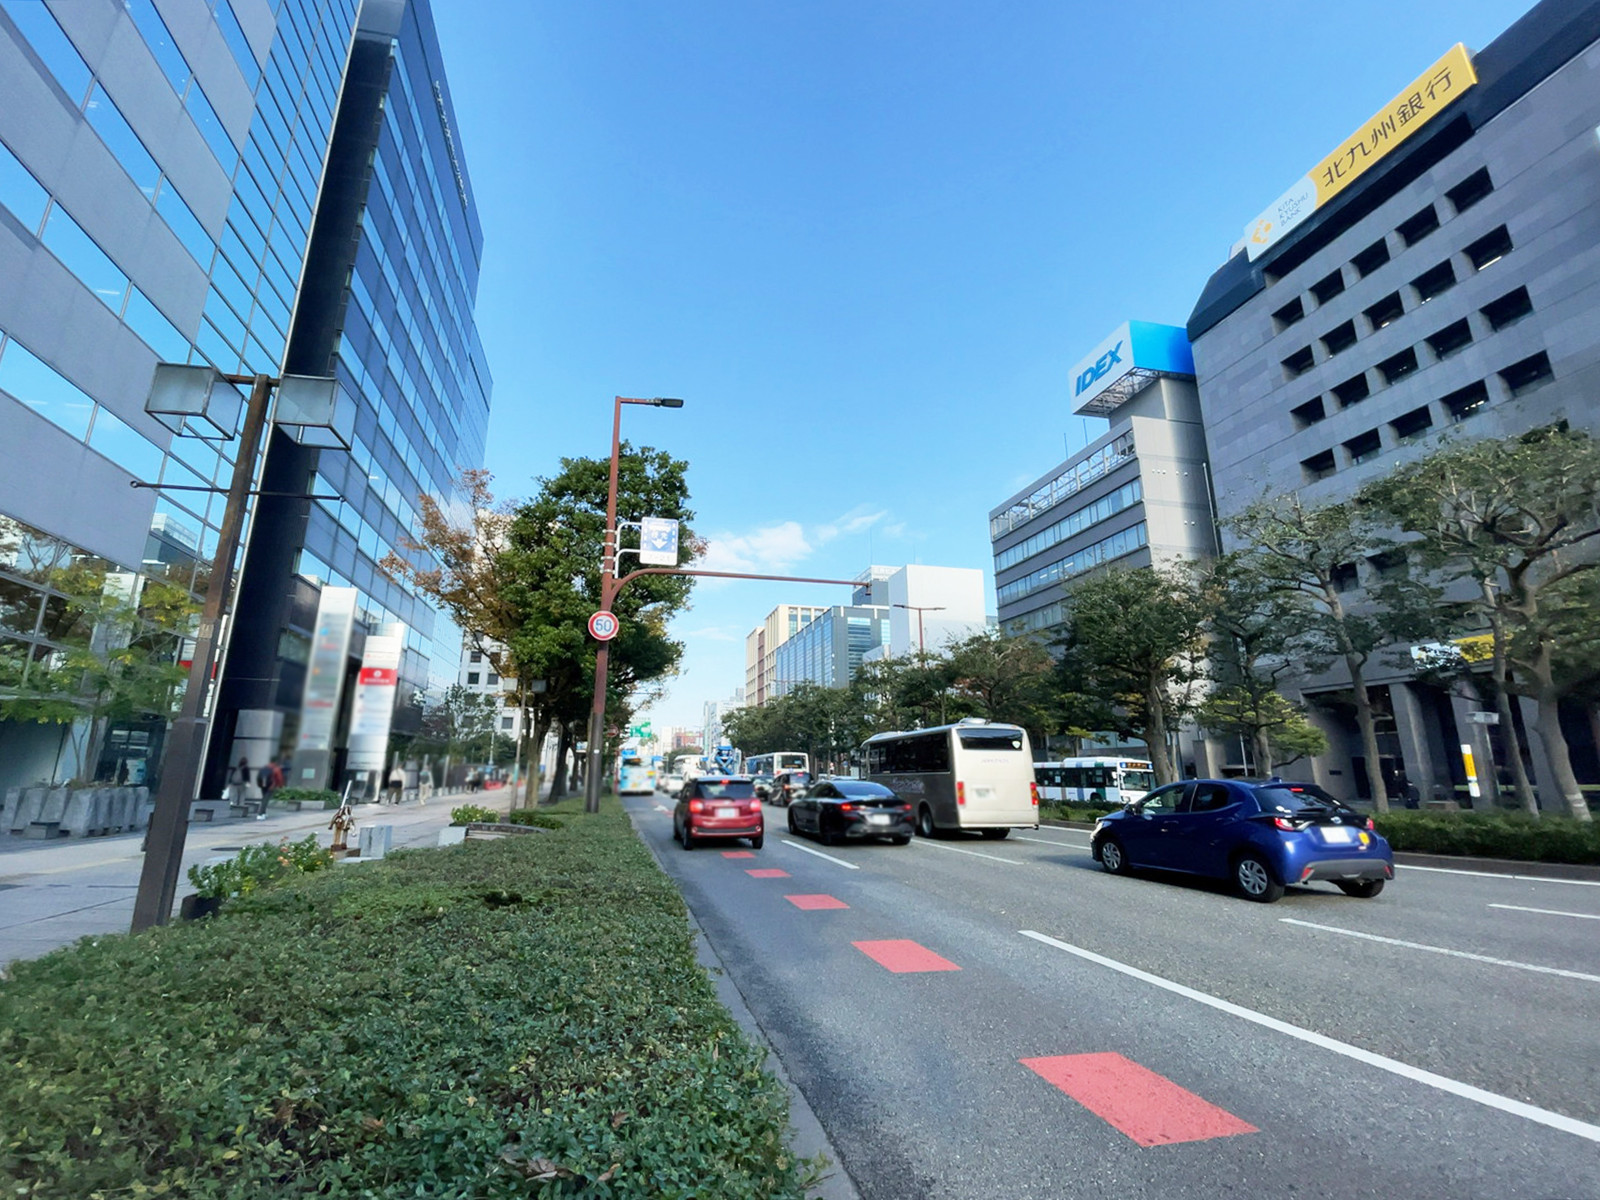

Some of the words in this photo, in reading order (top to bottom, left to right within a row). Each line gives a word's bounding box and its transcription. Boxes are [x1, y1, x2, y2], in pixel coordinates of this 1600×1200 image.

[1322, 66, 1452, 187] 北九州銀行
[1076, 340, 1123, 397] IDEX
[595, 618, 612, 632] 50
